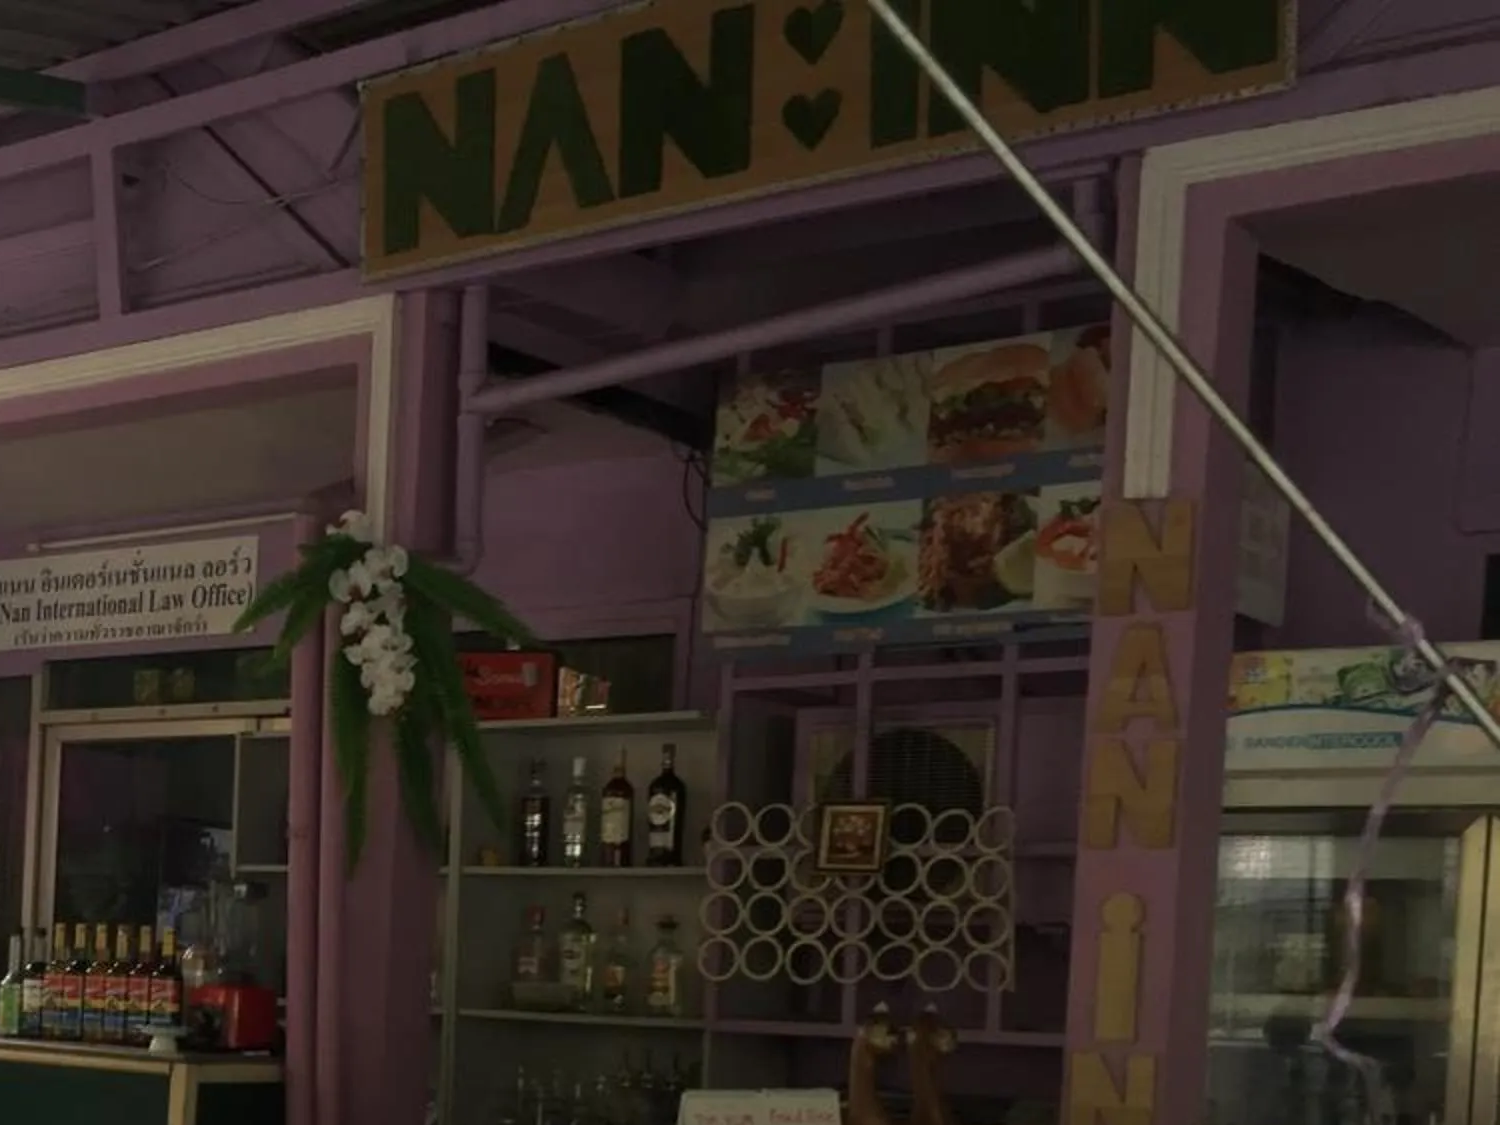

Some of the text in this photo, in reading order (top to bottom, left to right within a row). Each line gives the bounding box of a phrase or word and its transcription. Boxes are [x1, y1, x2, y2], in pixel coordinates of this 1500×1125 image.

[383, 12, 753, 256] NAN
[36, 591, 143, 622] International
[149, 588, 184, 613] Law
[191, 582, 254, 610] Office)
